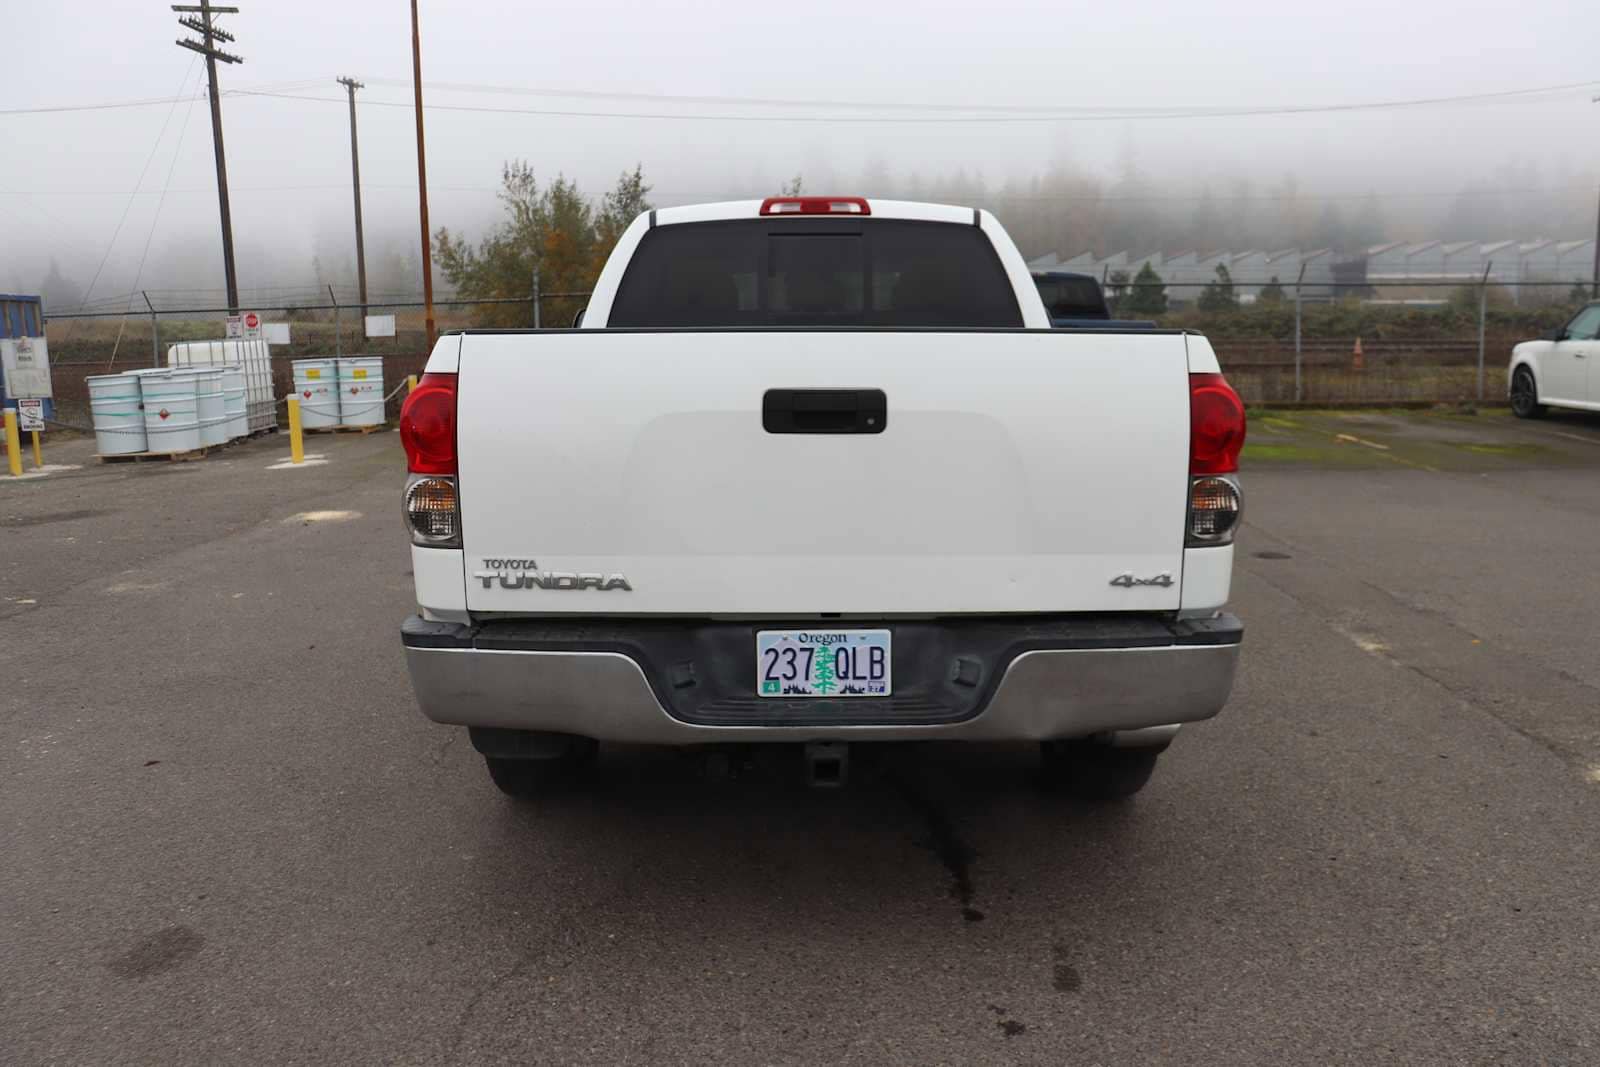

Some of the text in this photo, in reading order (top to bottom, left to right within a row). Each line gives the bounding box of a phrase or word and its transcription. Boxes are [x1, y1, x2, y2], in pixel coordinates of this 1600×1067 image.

[483, 559, 537, 570] TOYOTA
[474, 571, 632, 591] TUNDRA
[1109, 572, 1174, 588] 4x4
[798, 633, 847, 646] Oregon
[764, 646, 885, 681] 237 QLB
